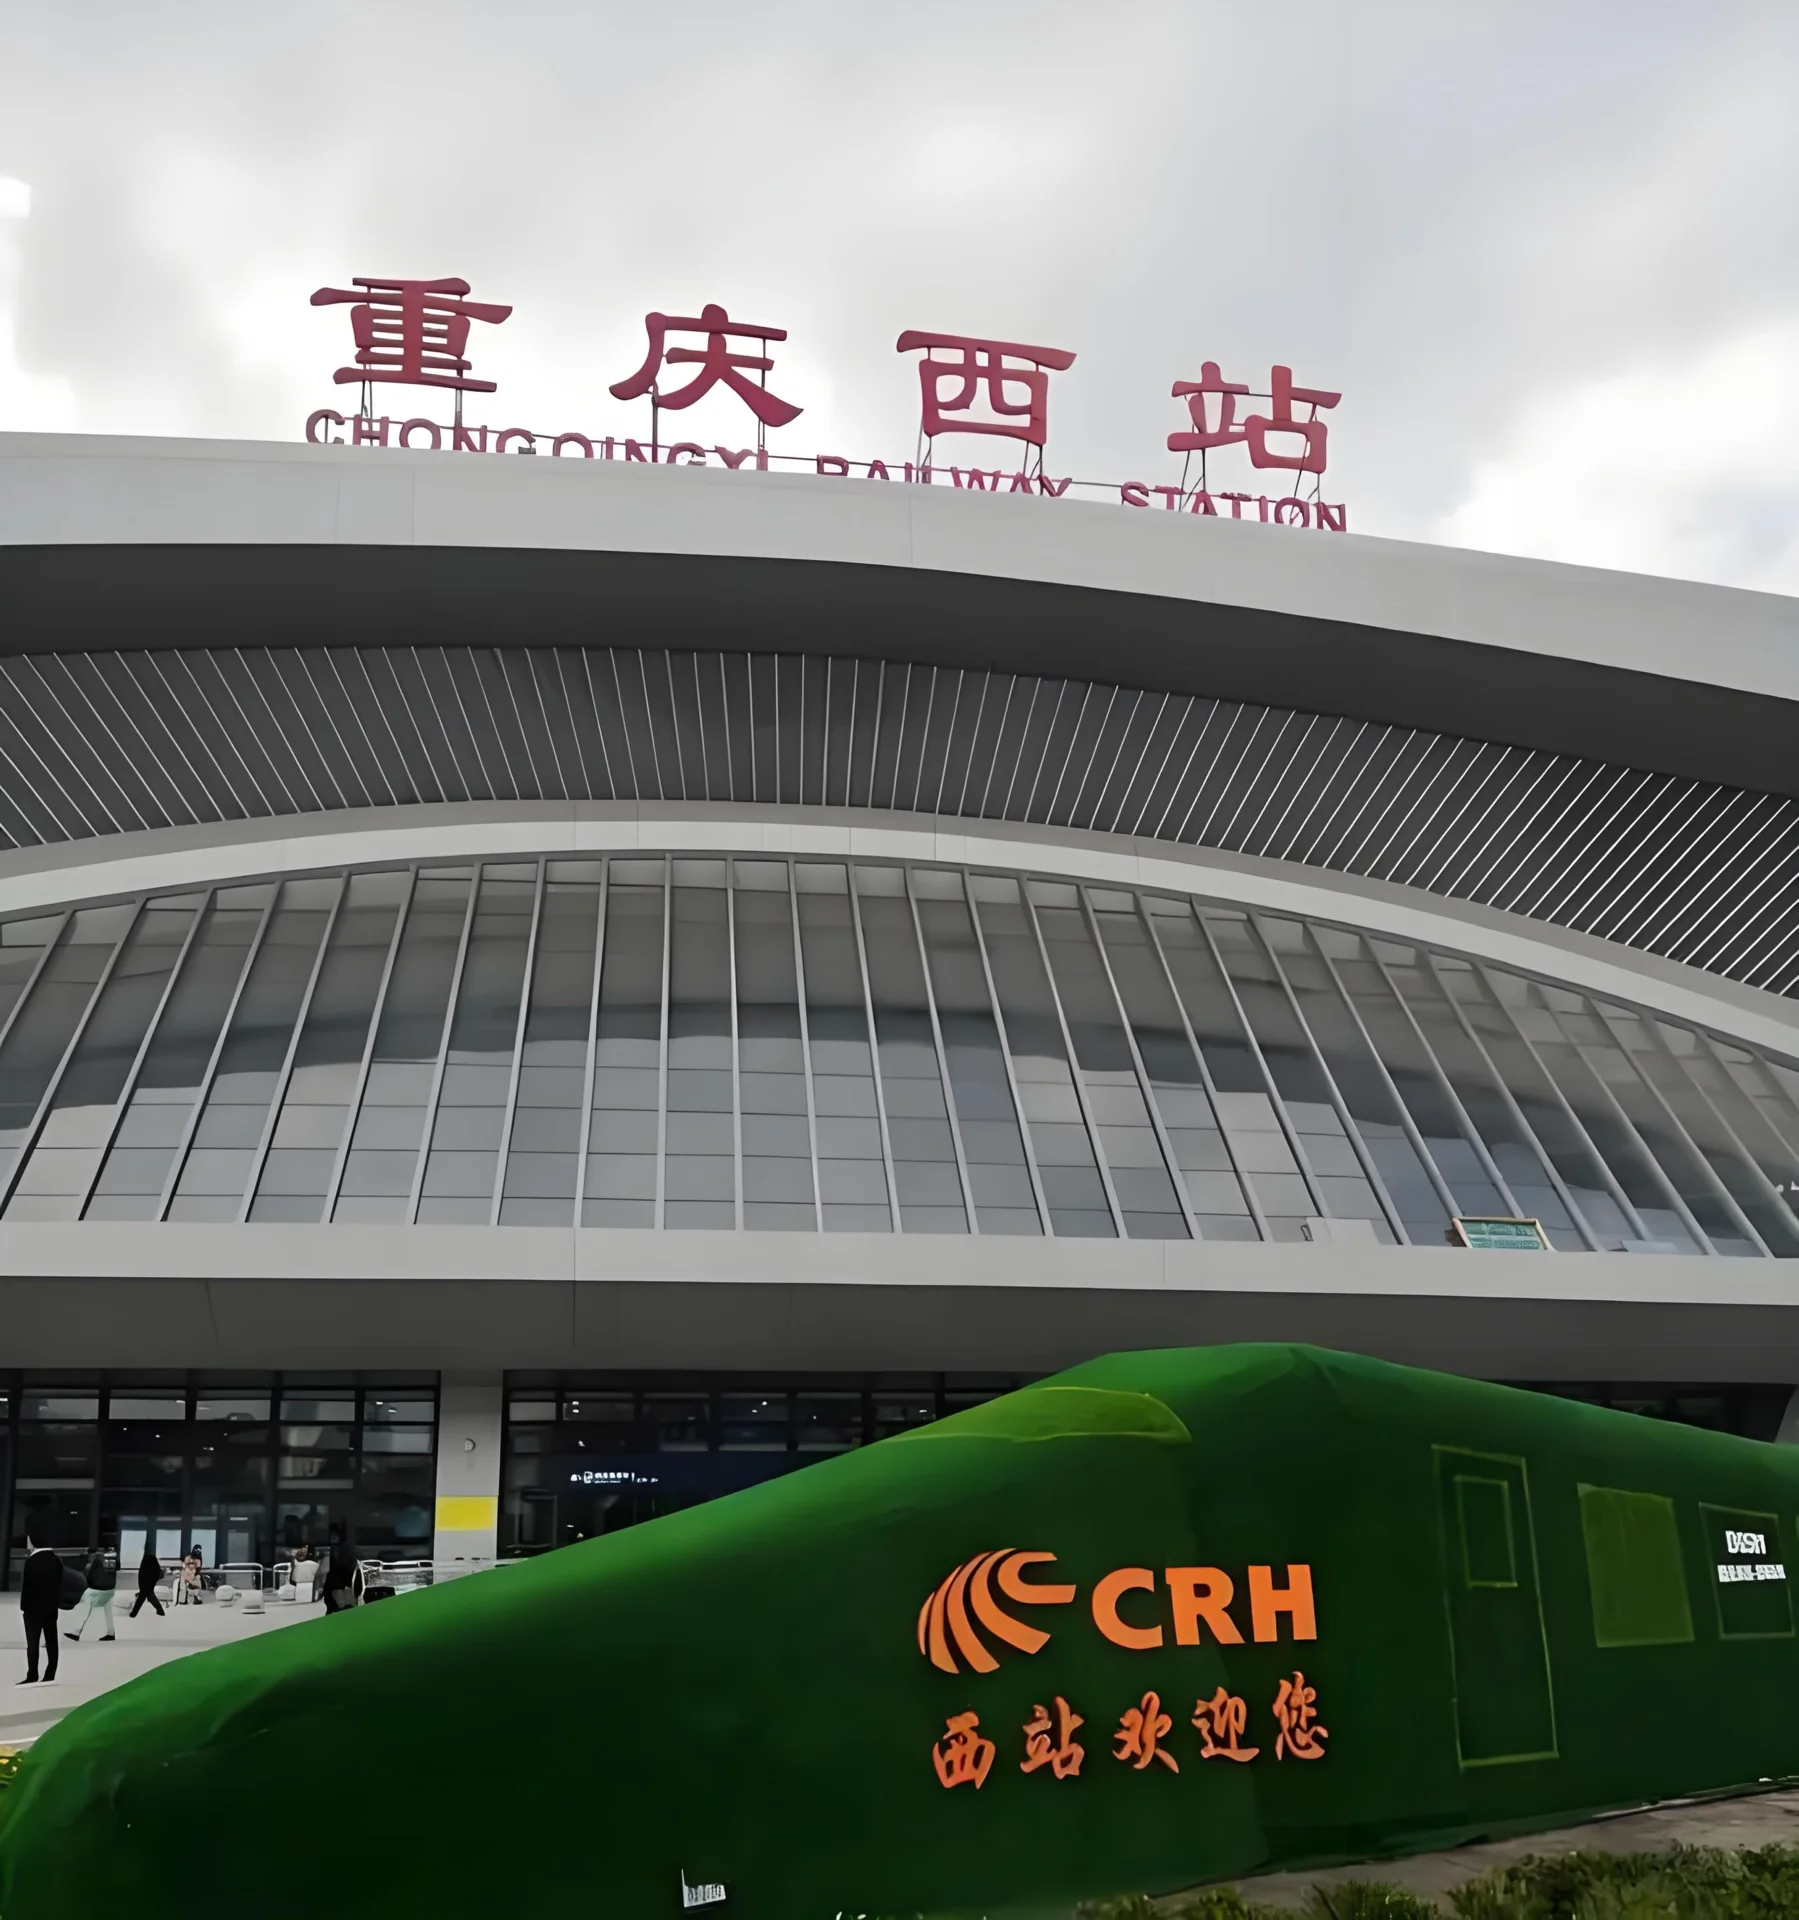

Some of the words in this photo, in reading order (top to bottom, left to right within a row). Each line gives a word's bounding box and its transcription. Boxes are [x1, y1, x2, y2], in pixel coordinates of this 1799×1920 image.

[310, 277, 1342, 474] 重庆西站
[1121, 481, 1346, 532] STATION
[1092, 1564, 1317, 1650] CRH
[932, 1671, 1329, 1789] 西站欢迎您
